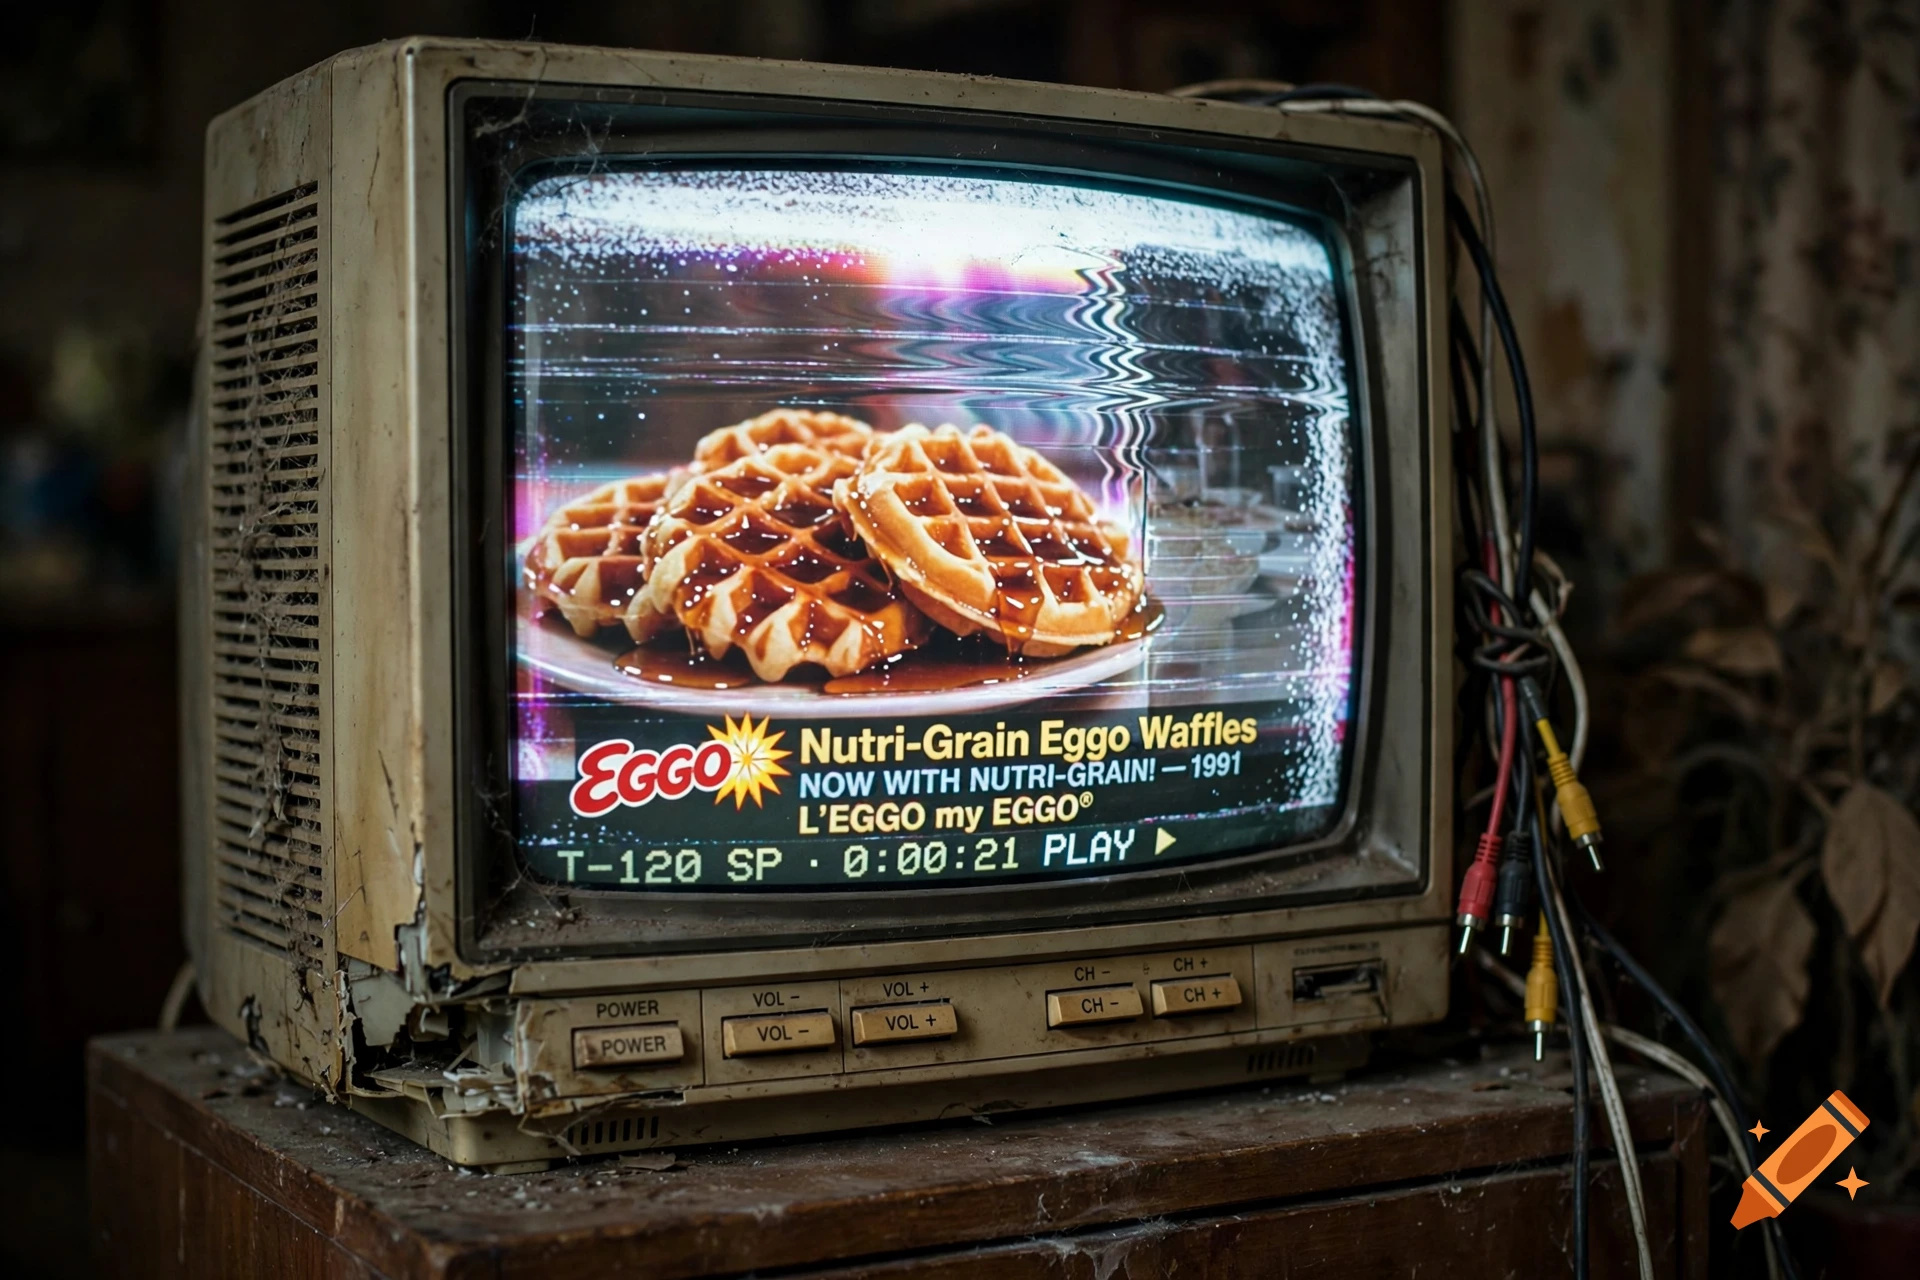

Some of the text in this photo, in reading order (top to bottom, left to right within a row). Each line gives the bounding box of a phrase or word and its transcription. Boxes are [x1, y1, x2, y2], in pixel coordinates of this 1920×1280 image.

[801, 712, 1257, 764] Nutri-Grain Eggo Waffles
[570, 739, 734, 817] EGGO
[801, 771, 875, 798] NOW
[884, 768, 960, 796] WITH
[970, 758, 1156, 792] NUTRI-GRAIN!
[1191, 751, 1240, 778] 1991
[801, 802, 925, 834] L'EGGO
[935, 803, 983, 833] my
[557, 849, 701, 884] T-120
[727, 847, 782, 881] SP
[843, 837, 1019, 878] 0:00:21
[1043, 829, 1135, 866] PLAY
[1173, 957, 1194, 972] CH
[1074, 966, 1095, 981] CH
[883, 982, 914, 997] VOL
[1184, 987, 1206, 1003] CH
[753, 992, 784, 1007] VOL
[1081, 998, 1103, 1014] CH
[596, 1001, 659, 1018] POWER
[885, 1014, 919, 1031] VOL
[757, 1025, 792, 1042] VOL
[602, 1036, 667, 1056] POWER
